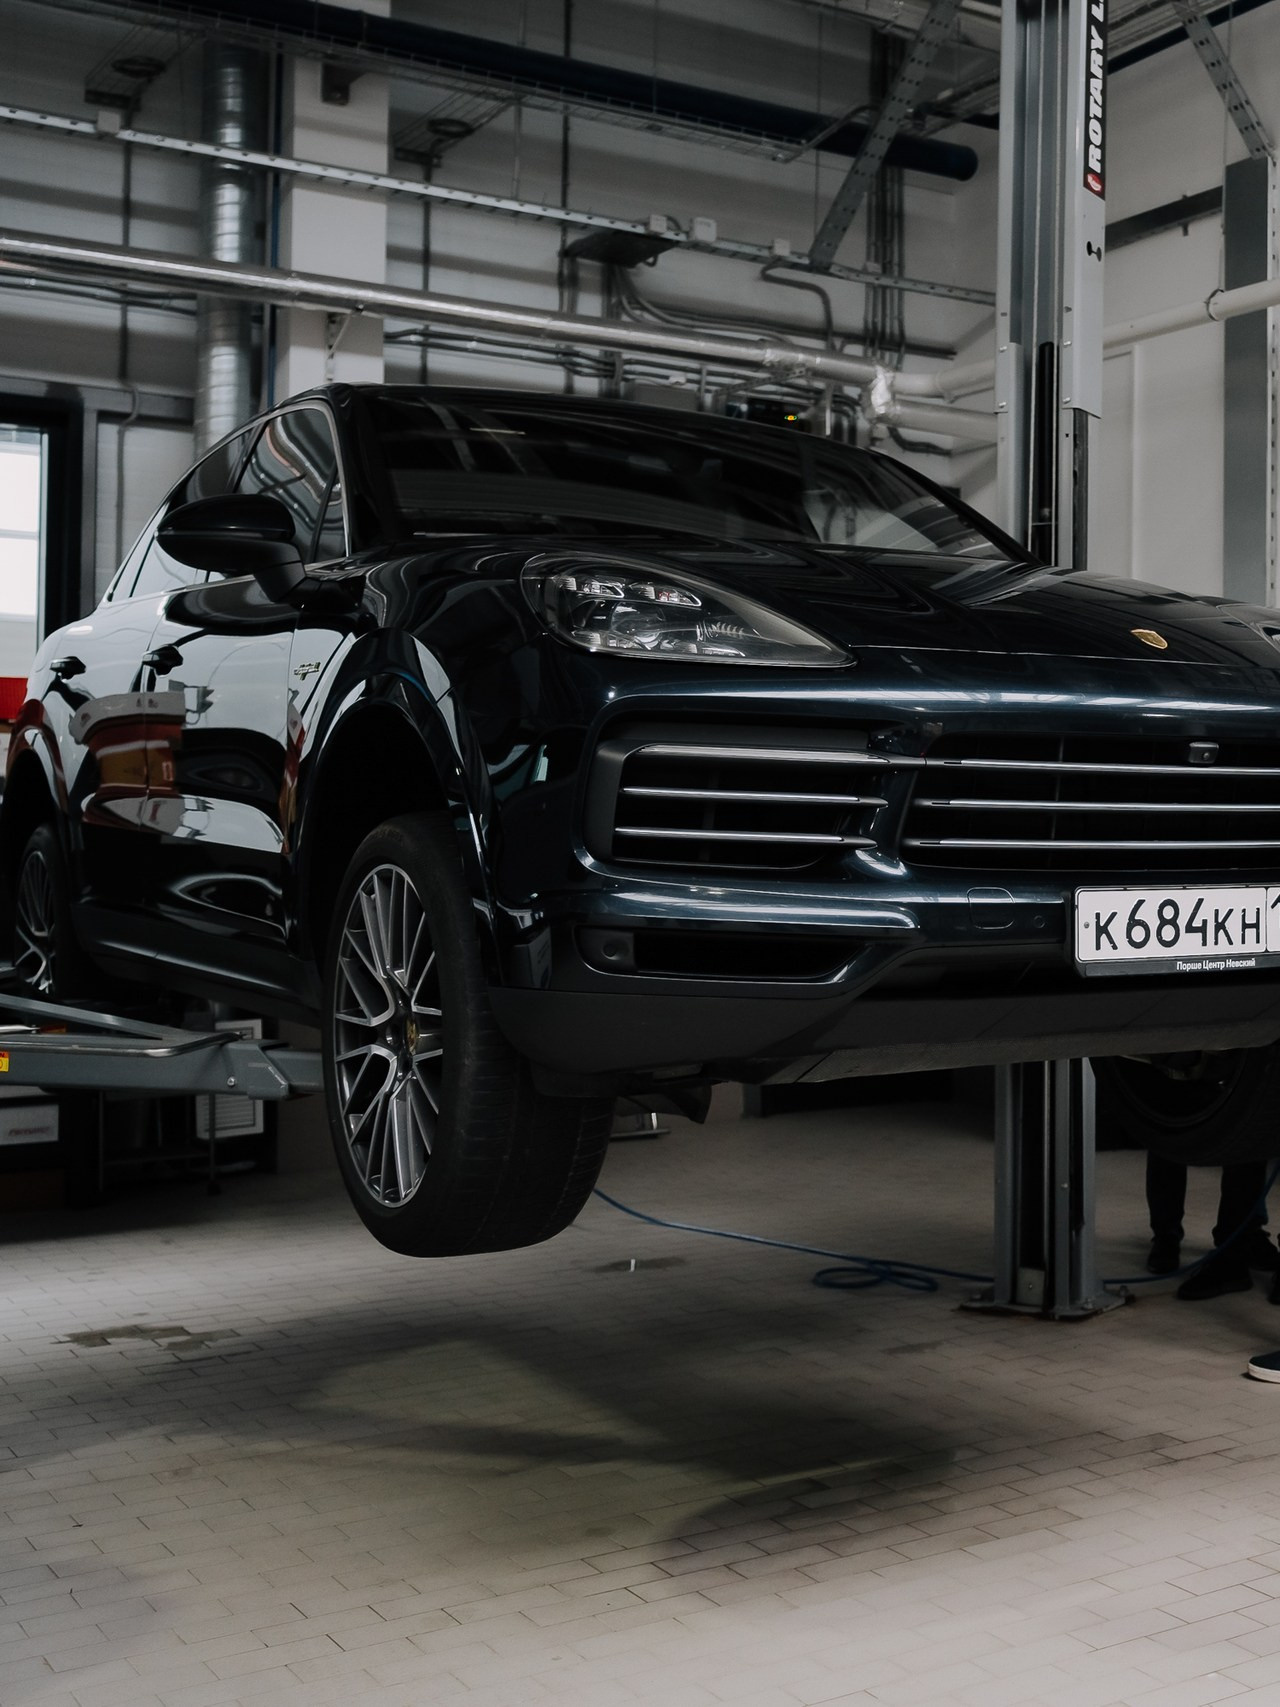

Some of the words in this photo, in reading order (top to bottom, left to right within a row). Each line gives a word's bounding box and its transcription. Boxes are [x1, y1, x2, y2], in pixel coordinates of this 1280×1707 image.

[1088, 25, 1104, 174] ROTARY
[1176, 961, 1202, 972] Порше
[1202, 960, 1225, 970] Центр
[1225, 957, 1256, 968] Невский
